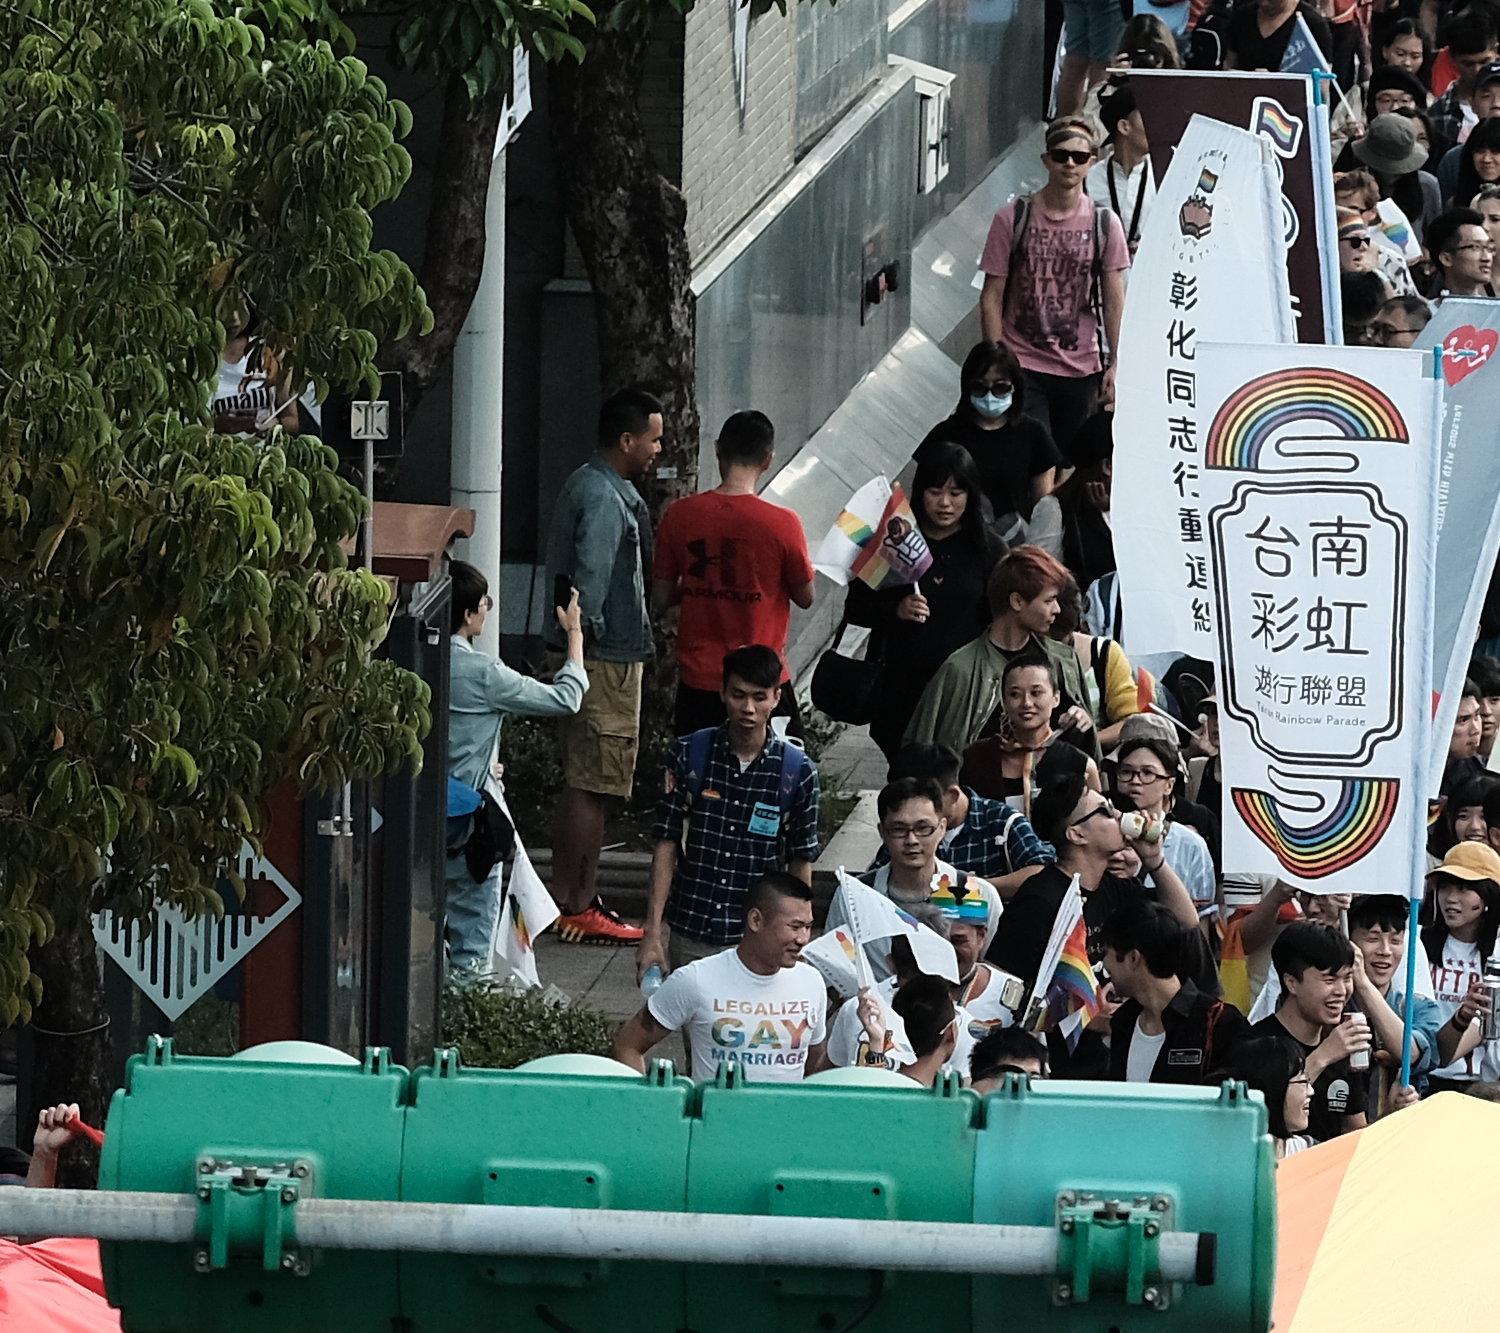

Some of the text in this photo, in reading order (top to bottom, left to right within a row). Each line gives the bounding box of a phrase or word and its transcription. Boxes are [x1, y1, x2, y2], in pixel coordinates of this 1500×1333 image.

[1245, 515, 1371, 578] 台南
[1250, 590, 1370, 656] 彩虹
[1254, 664, 1367, 708] 遊行聯盟
[1326, 715, 1367, 727] Parade
[712, 997, 810, 1016] LEGALIZE
[711, 1016, 809, 1050] GAY
[711, 1047, 806, 1066] MARRIAGE
